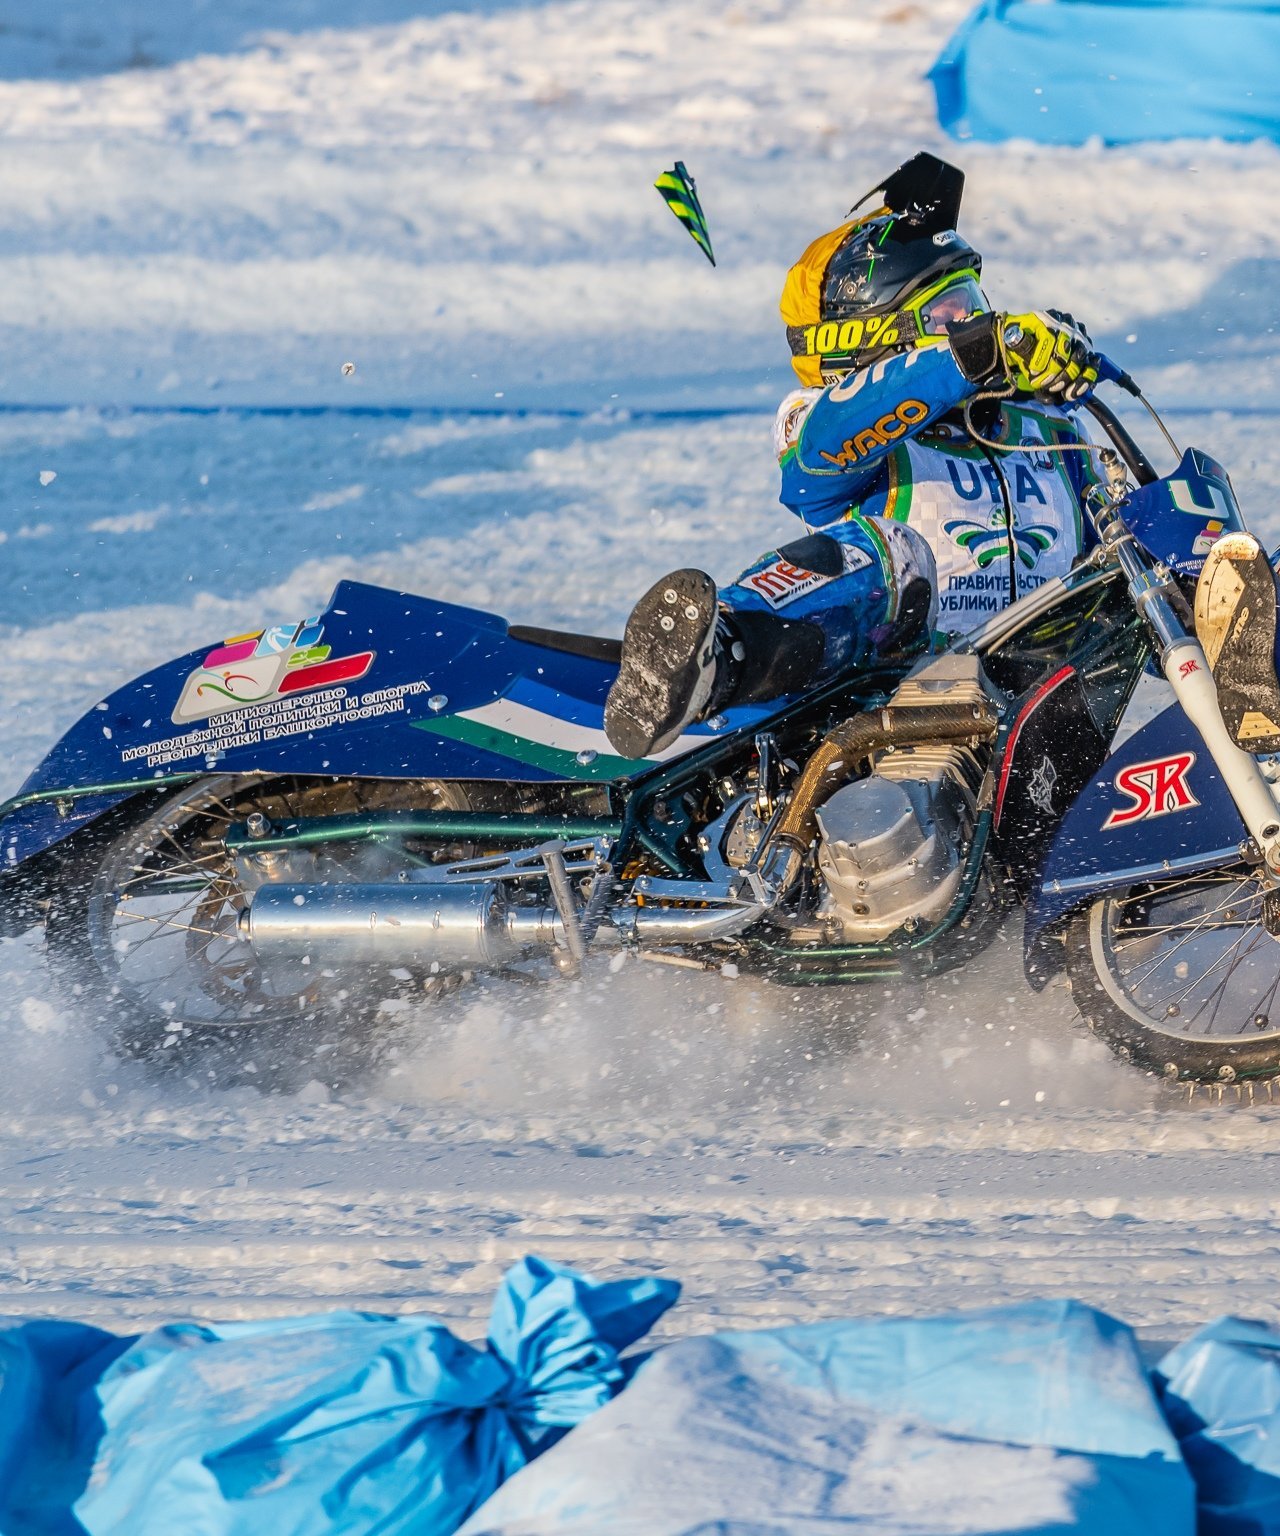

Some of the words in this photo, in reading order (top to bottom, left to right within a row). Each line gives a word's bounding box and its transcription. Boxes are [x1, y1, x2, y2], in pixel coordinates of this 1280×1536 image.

[803, 314, 899, 355] 100%
[819, 399, 930, 467] WACO
[945, 459, 1047, 505] UFA
[122, 721, 245, 762] МОЛОДЕЖНОЙ
[249, 701, 341, 730] ПОЛИТИКИ
[345, 694, 359, 709] И
[362, 680, 432, 705] СПОРТА
[147, 730, 262, 767] РЕСПУБЛИКИ
[264, 699, 404, 739] БАШКОРТОСТАН
[208, 687, 347, 728] МИНИСТЕРСТВО
[1103, 752, 1199, 829] SR
